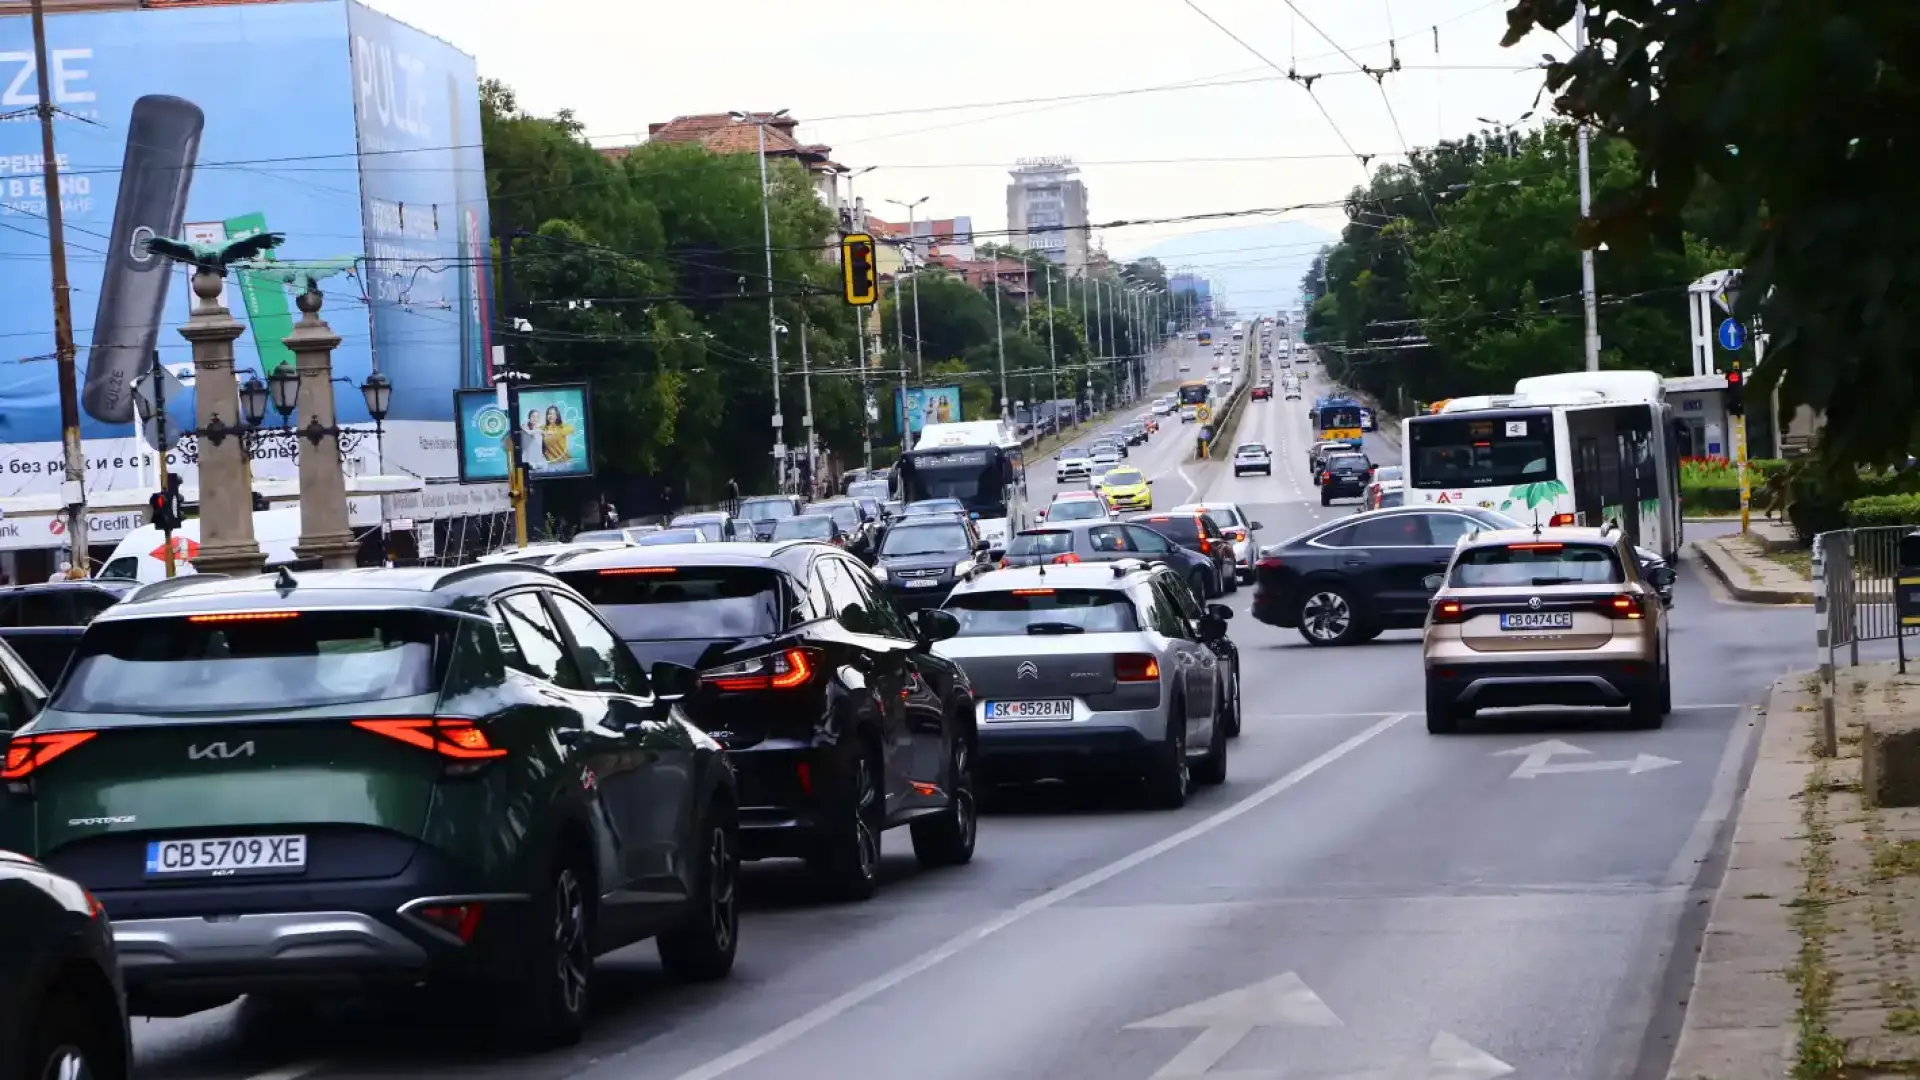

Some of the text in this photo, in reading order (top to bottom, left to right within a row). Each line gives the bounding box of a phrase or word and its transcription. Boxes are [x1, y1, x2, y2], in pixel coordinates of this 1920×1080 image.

[30, 177, 90, 197] ЕНО
[9, 459, 41, 474] без
[86, 515, 129, 532] Credit
[1525, 614, 1552, 625] 0474
[995, 701, 1070, 716] SK 9528 AN
[188, 740, 255, 760] KIA
[163, 837, 301, 869] CB 5709 XE
